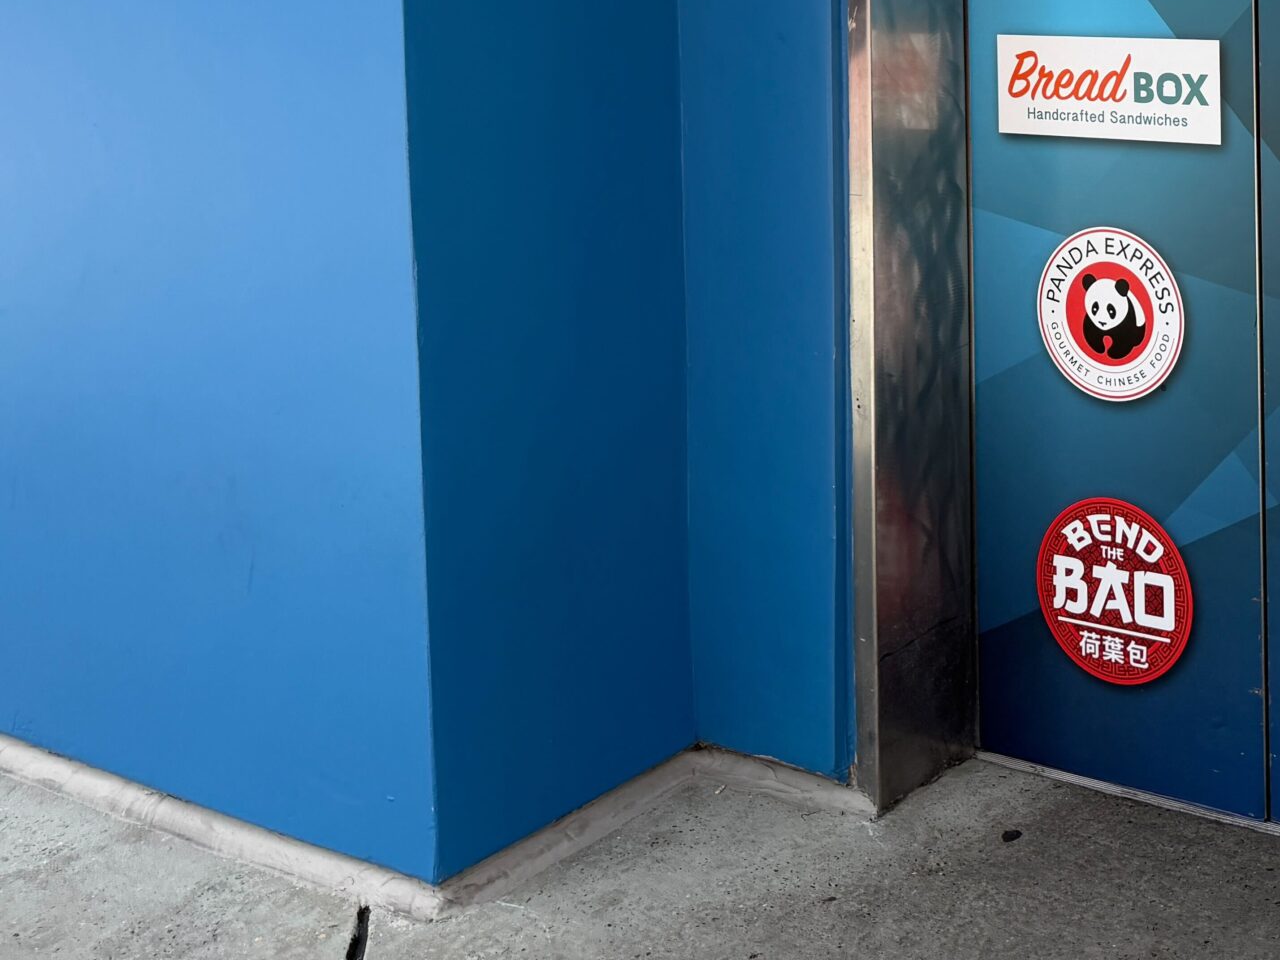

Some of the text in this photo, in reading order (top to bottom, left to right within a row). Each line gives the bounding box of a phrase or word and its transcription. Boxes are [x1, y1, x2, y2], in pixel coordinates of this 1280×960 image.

[1008, 50, 1209, 106] Bread BOX
[1027, 107, 1188, 127] Handcrafted Sandwiches
[1046, 238, 1174, 314] PANDA EXPRESS
[1051, 321, 1170, 387] GOURMET CHINESE FOOD
[1061, 514, 1164, 563] BEND
[1100, 545, 1124, 561] THE
[1053, 554, 1175, 631] BAO
[1079, 630, 1149, 669] 荷葉包
